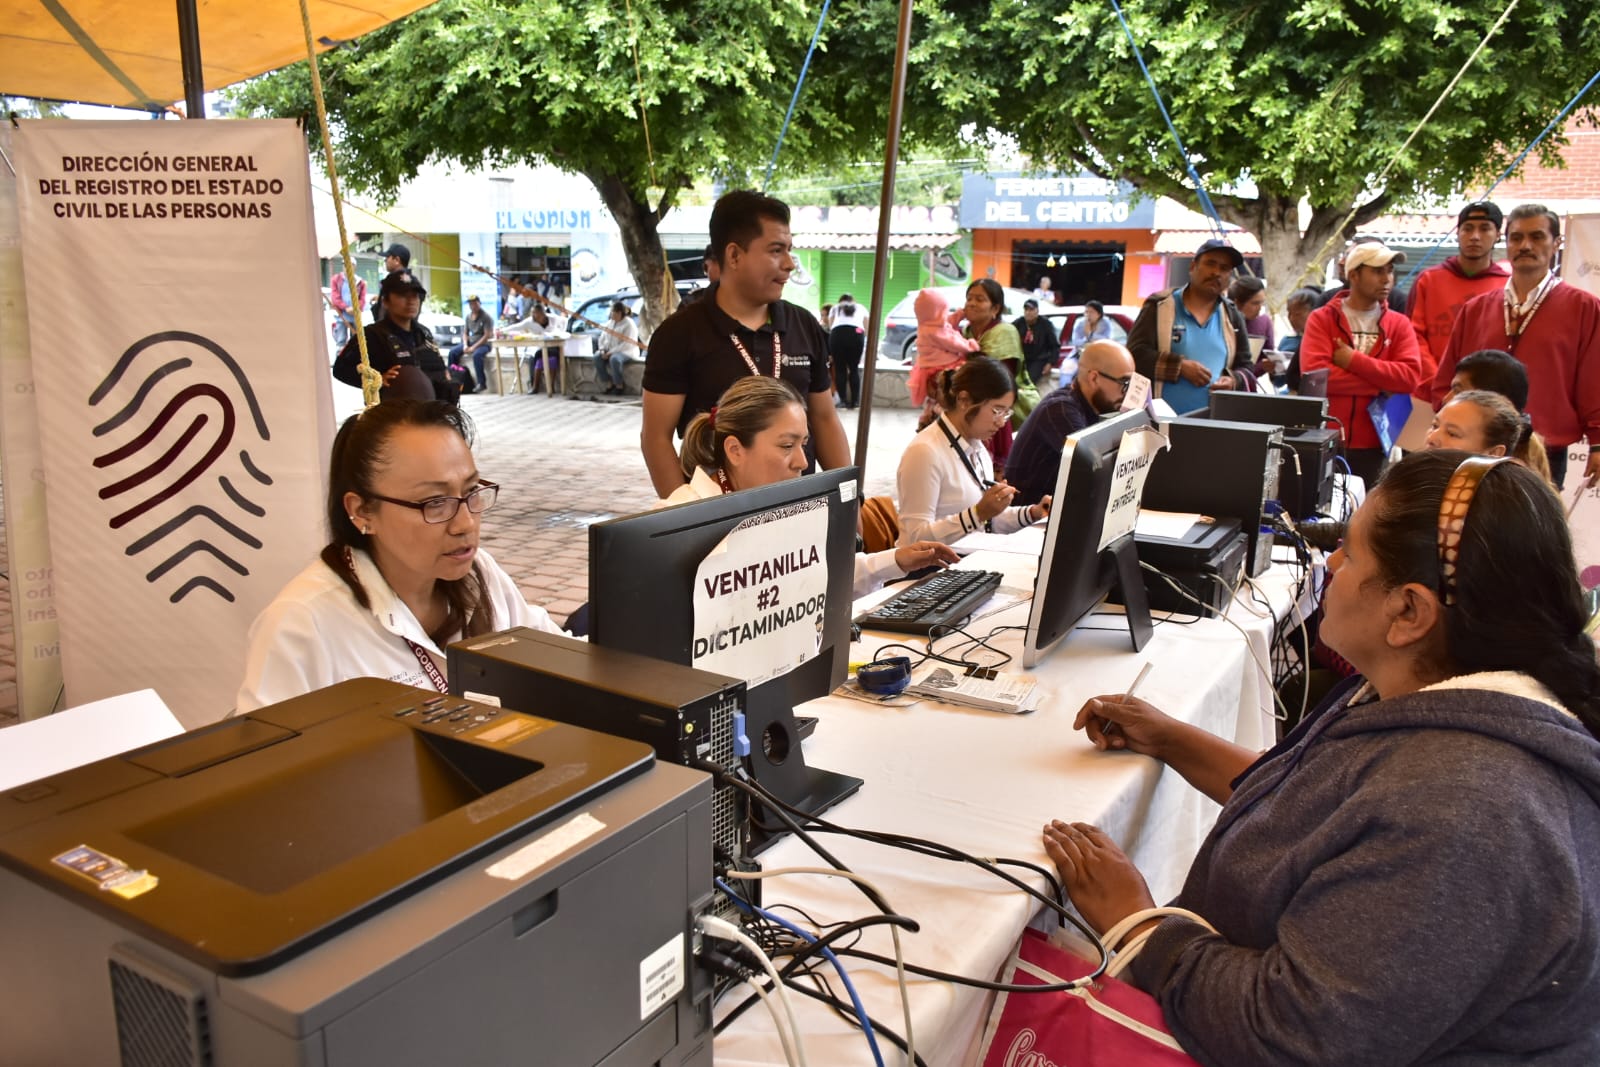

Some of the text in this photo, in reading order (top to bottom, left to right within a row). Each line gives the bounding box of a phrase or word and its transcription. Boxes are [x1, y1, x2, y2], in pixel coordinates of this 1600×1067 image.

[62, 151, 258, 172] DIRECCIÓN GENERAL
[39, 179, 284, 196] DEL REGISTRO DEL ESTADO
[53, 202, 272, 219] CIVIL DE LAS PERSONAS
[496, 210, 517, 229] EL
[985, 200, 1030, 222] DEL
[1036, 201, 1129, 223] CENTRO
[1115, 453, 1149, 480] VENTANILLA
[704, 545, 820, 599] VENTANILLA
[756, 585, 780, 612] #2
[693, 592, 825, 660] DICTAMINADOR
[415, 646, 449, 695] GOBERN
